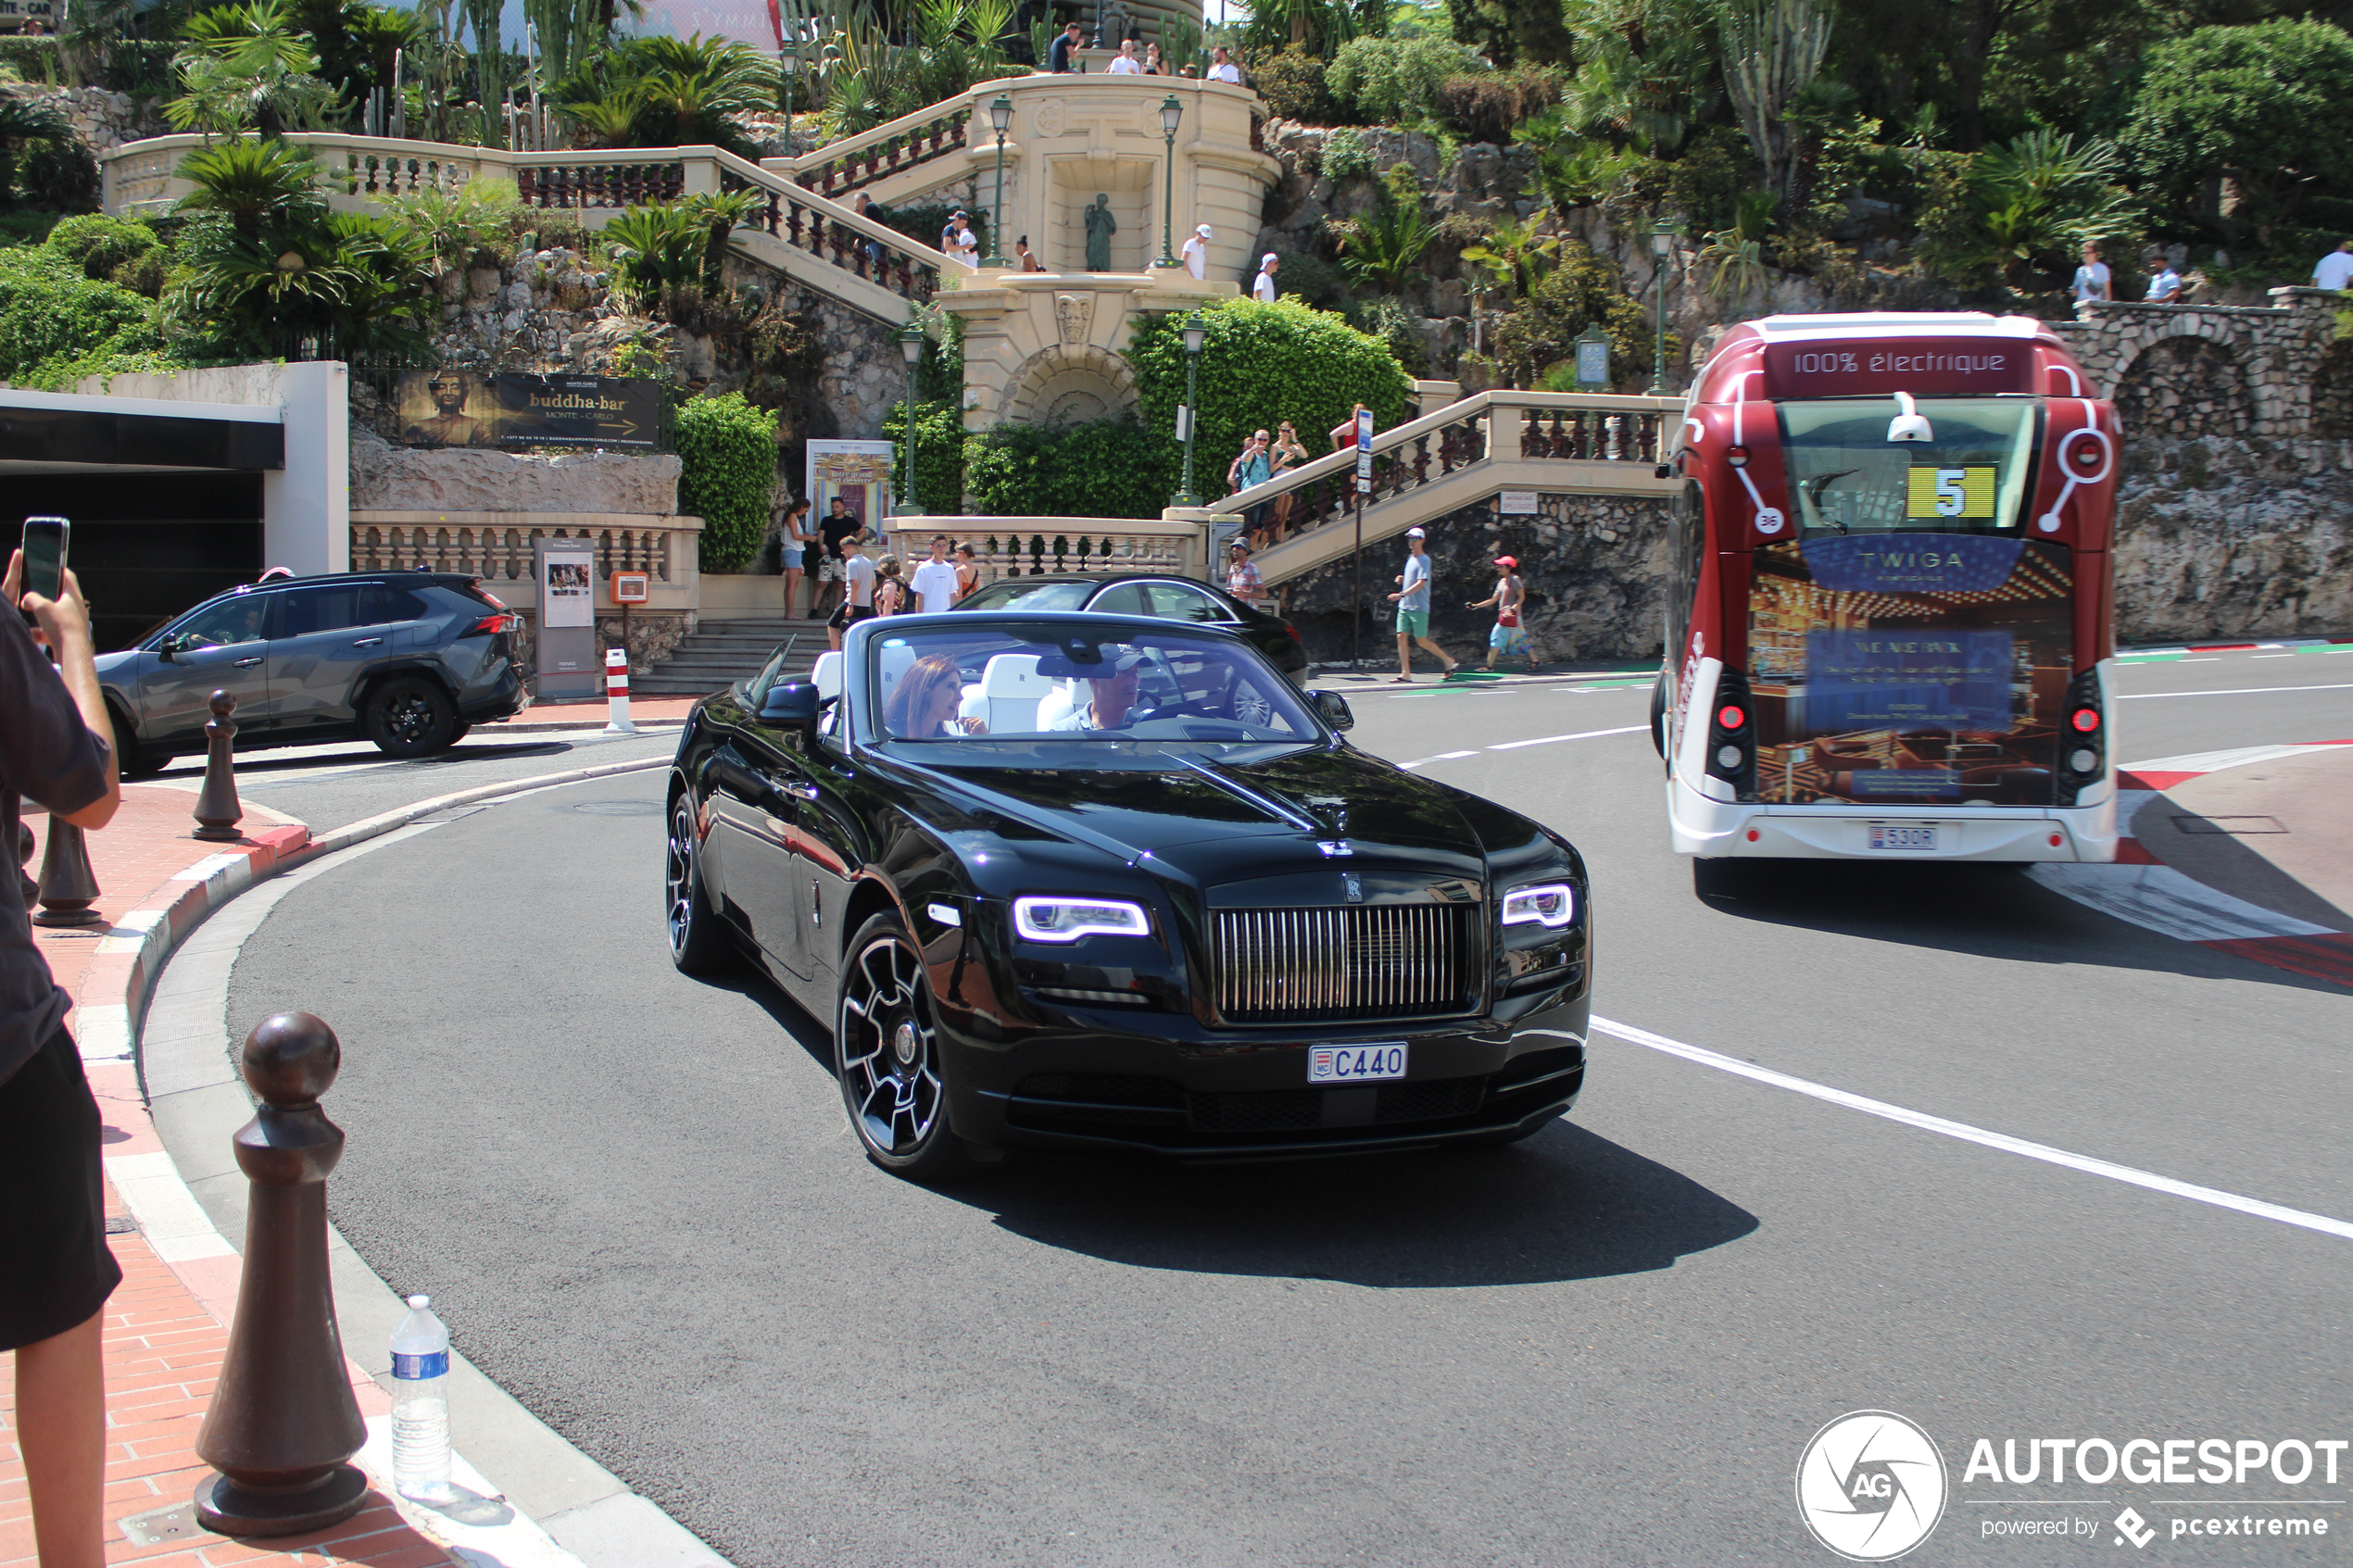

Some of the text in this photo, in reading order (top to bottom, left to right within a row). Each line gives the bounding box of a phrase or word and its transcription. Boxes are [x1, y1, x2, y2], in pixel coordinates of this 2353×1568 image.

[1794, 351, 2006, 375] 100% électrique
[529, 393, 625, 411] buddha-bar
[850, 470, 873, 479] grand
[1935, 469, 1966, 517] 5
[1760, 515, 1779, 528] 36
[1859, 553, 1964, 568] TWIGA
[1336, 1047, 1403, 1077] C440
